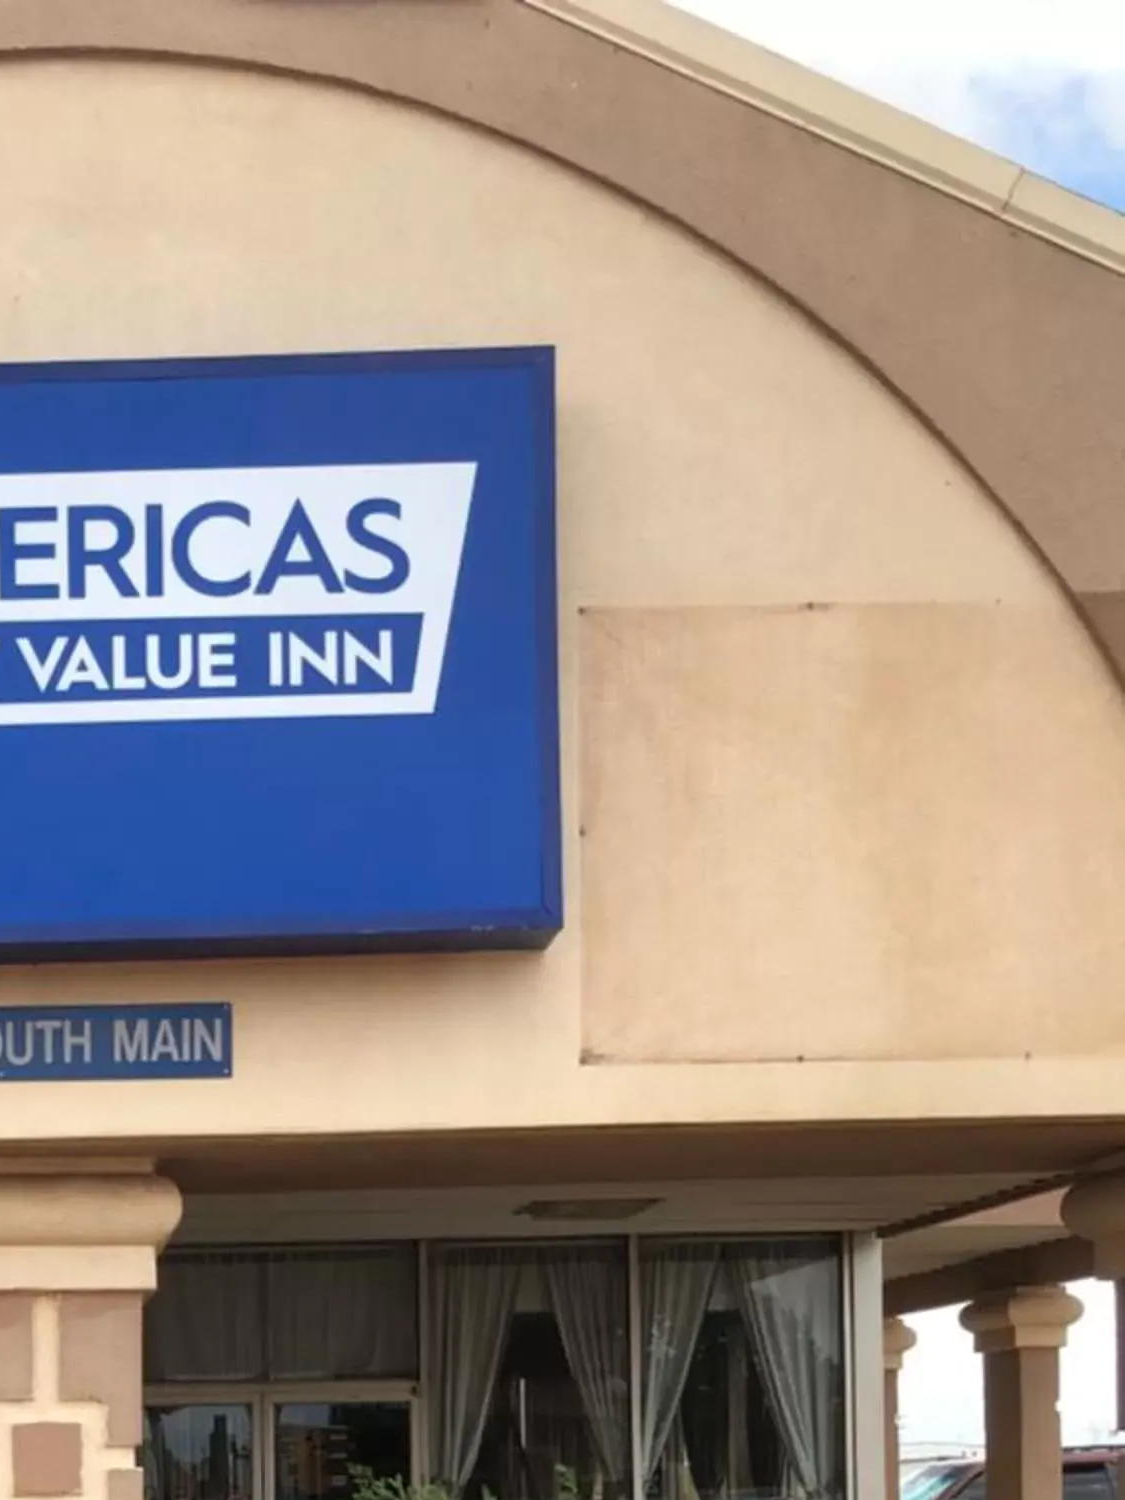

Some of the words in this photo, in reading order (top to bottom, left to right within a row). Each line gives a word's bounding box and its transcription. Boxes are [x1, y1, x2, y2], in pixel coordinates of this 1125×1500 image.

[17, 632, 237, 692] VALUE
[269, 629, 393, 687] INN
[113, 1018, 223, 1064] MAIN
